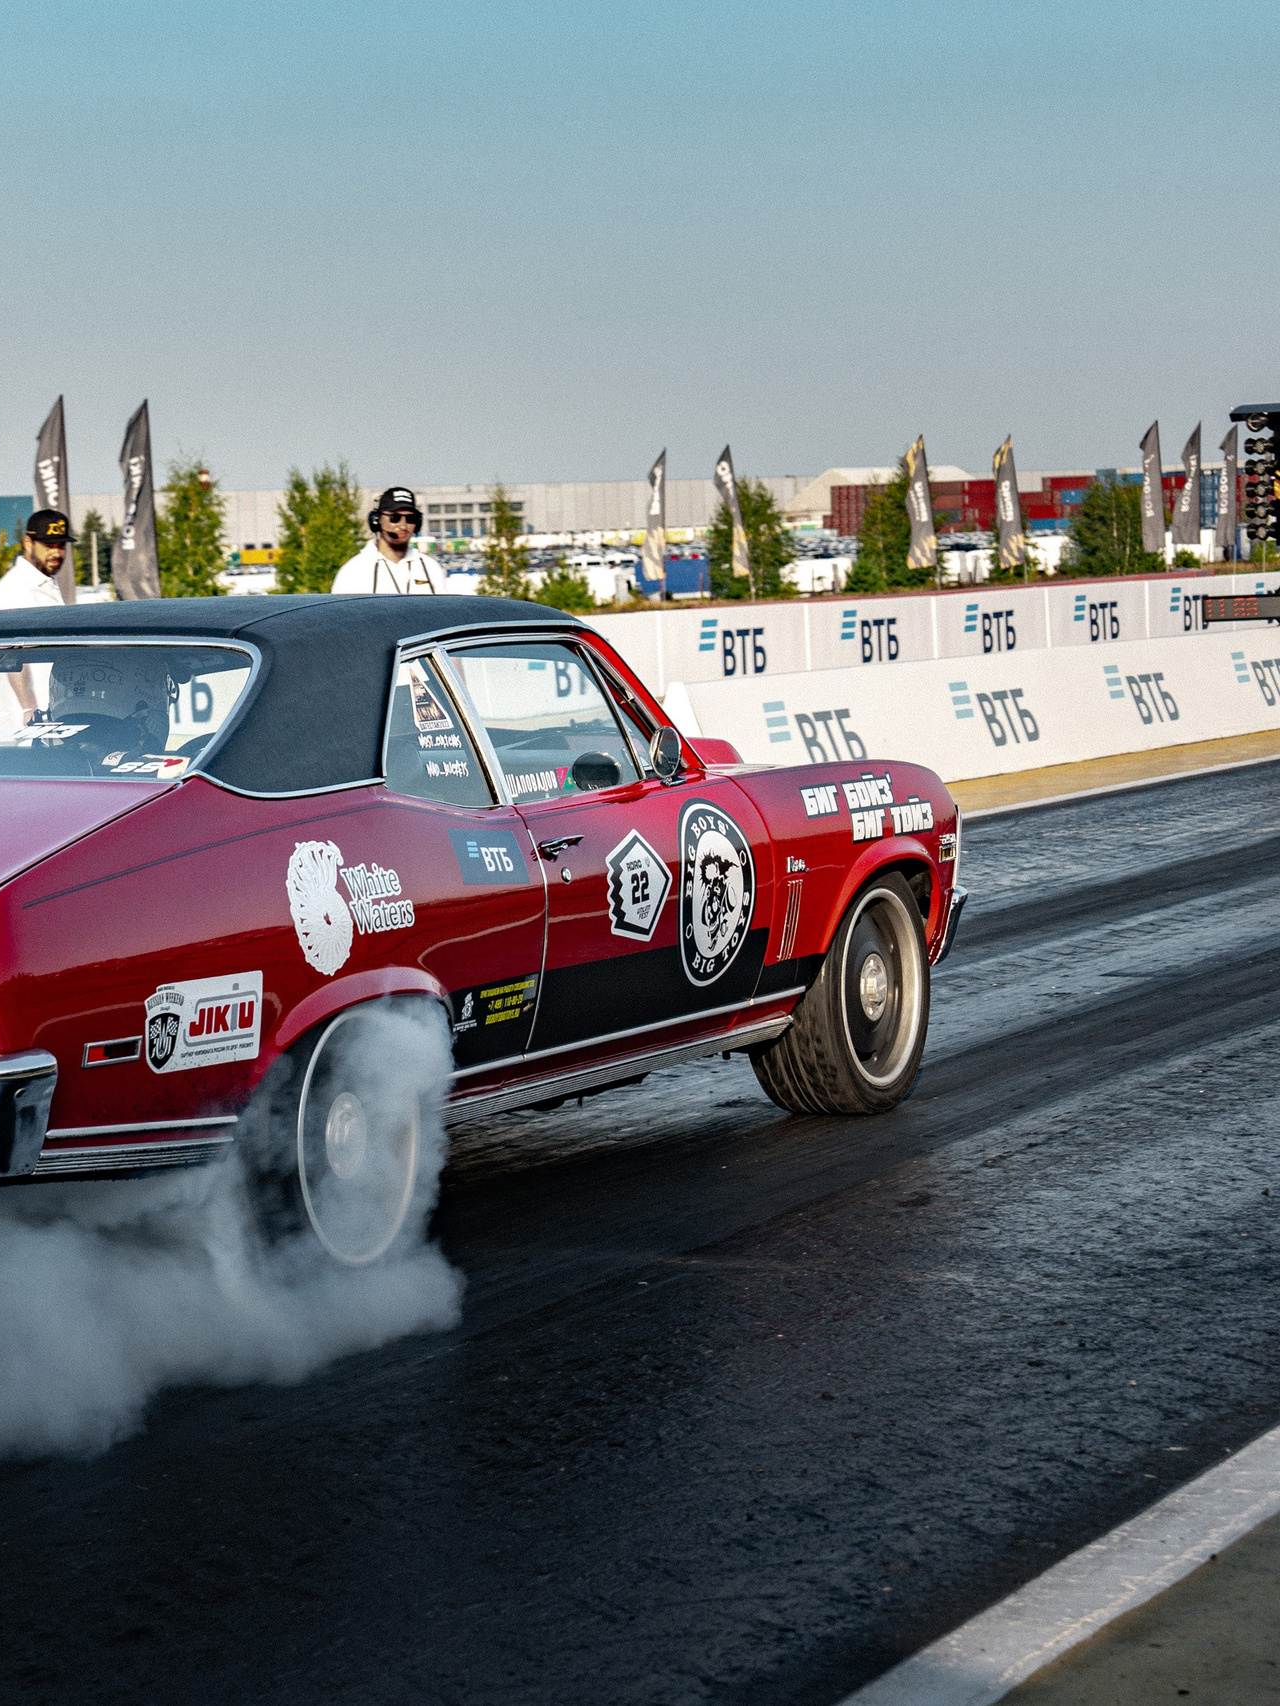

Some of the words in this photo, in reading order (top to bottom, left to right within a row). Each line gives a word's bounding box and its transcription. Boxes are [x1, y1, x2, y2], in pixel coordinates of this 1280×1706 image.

[861, 618, 900, 663] ВТБ
[982, 610, 1017, 654] ВТБ
[1089, 601, 1120, 642] ВТБ
[722, 627, 767, 677] ВТБ
[976, 688, 1040, 747] ВТБ
[1126, 672, 1180, 725] ВТБ
[794, 708, 868, 764] ВТБ
[505, 770, 559, 798] ШАПОВАЛОВ
[800, 785, 838, 816] БИГ
[851, 809, 886, 842] БИГ
[889, 797, 934, 834] ТОЙЗ
[480, 846, 514, 872] ВТБ
[341, 865, 402, 900] White
[631, 870, 650, 905] 22
[350, 902, 414, 932] Waters
[691, 951, 715, 974] BIG
